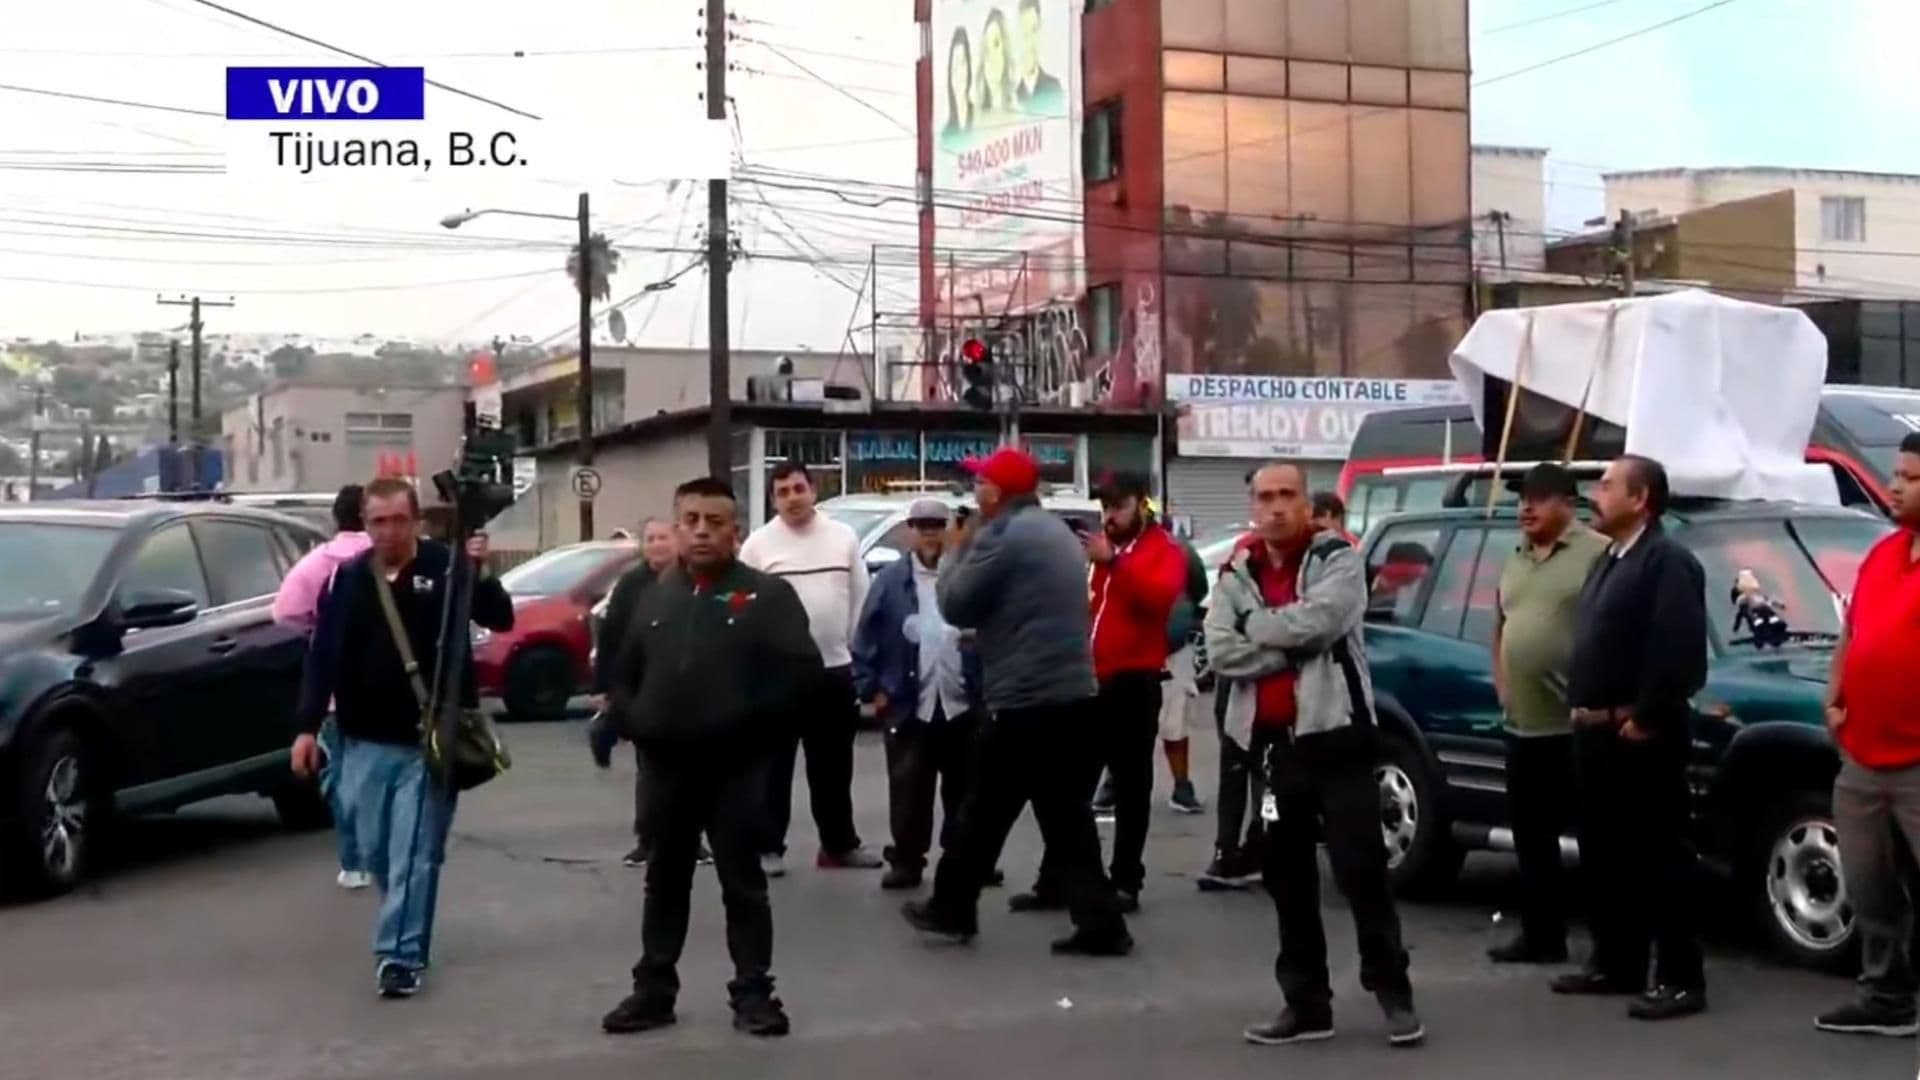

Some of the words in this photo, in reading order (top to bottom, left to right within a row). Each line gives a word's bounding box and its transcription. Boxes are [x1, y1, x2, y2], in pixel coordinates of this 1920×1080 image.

[1189, 377, 1297, 399] DESPACHO
[1302, 380, 1408, 401] CONTABLE
[1193, 404, 1310, 441] TRENDY
